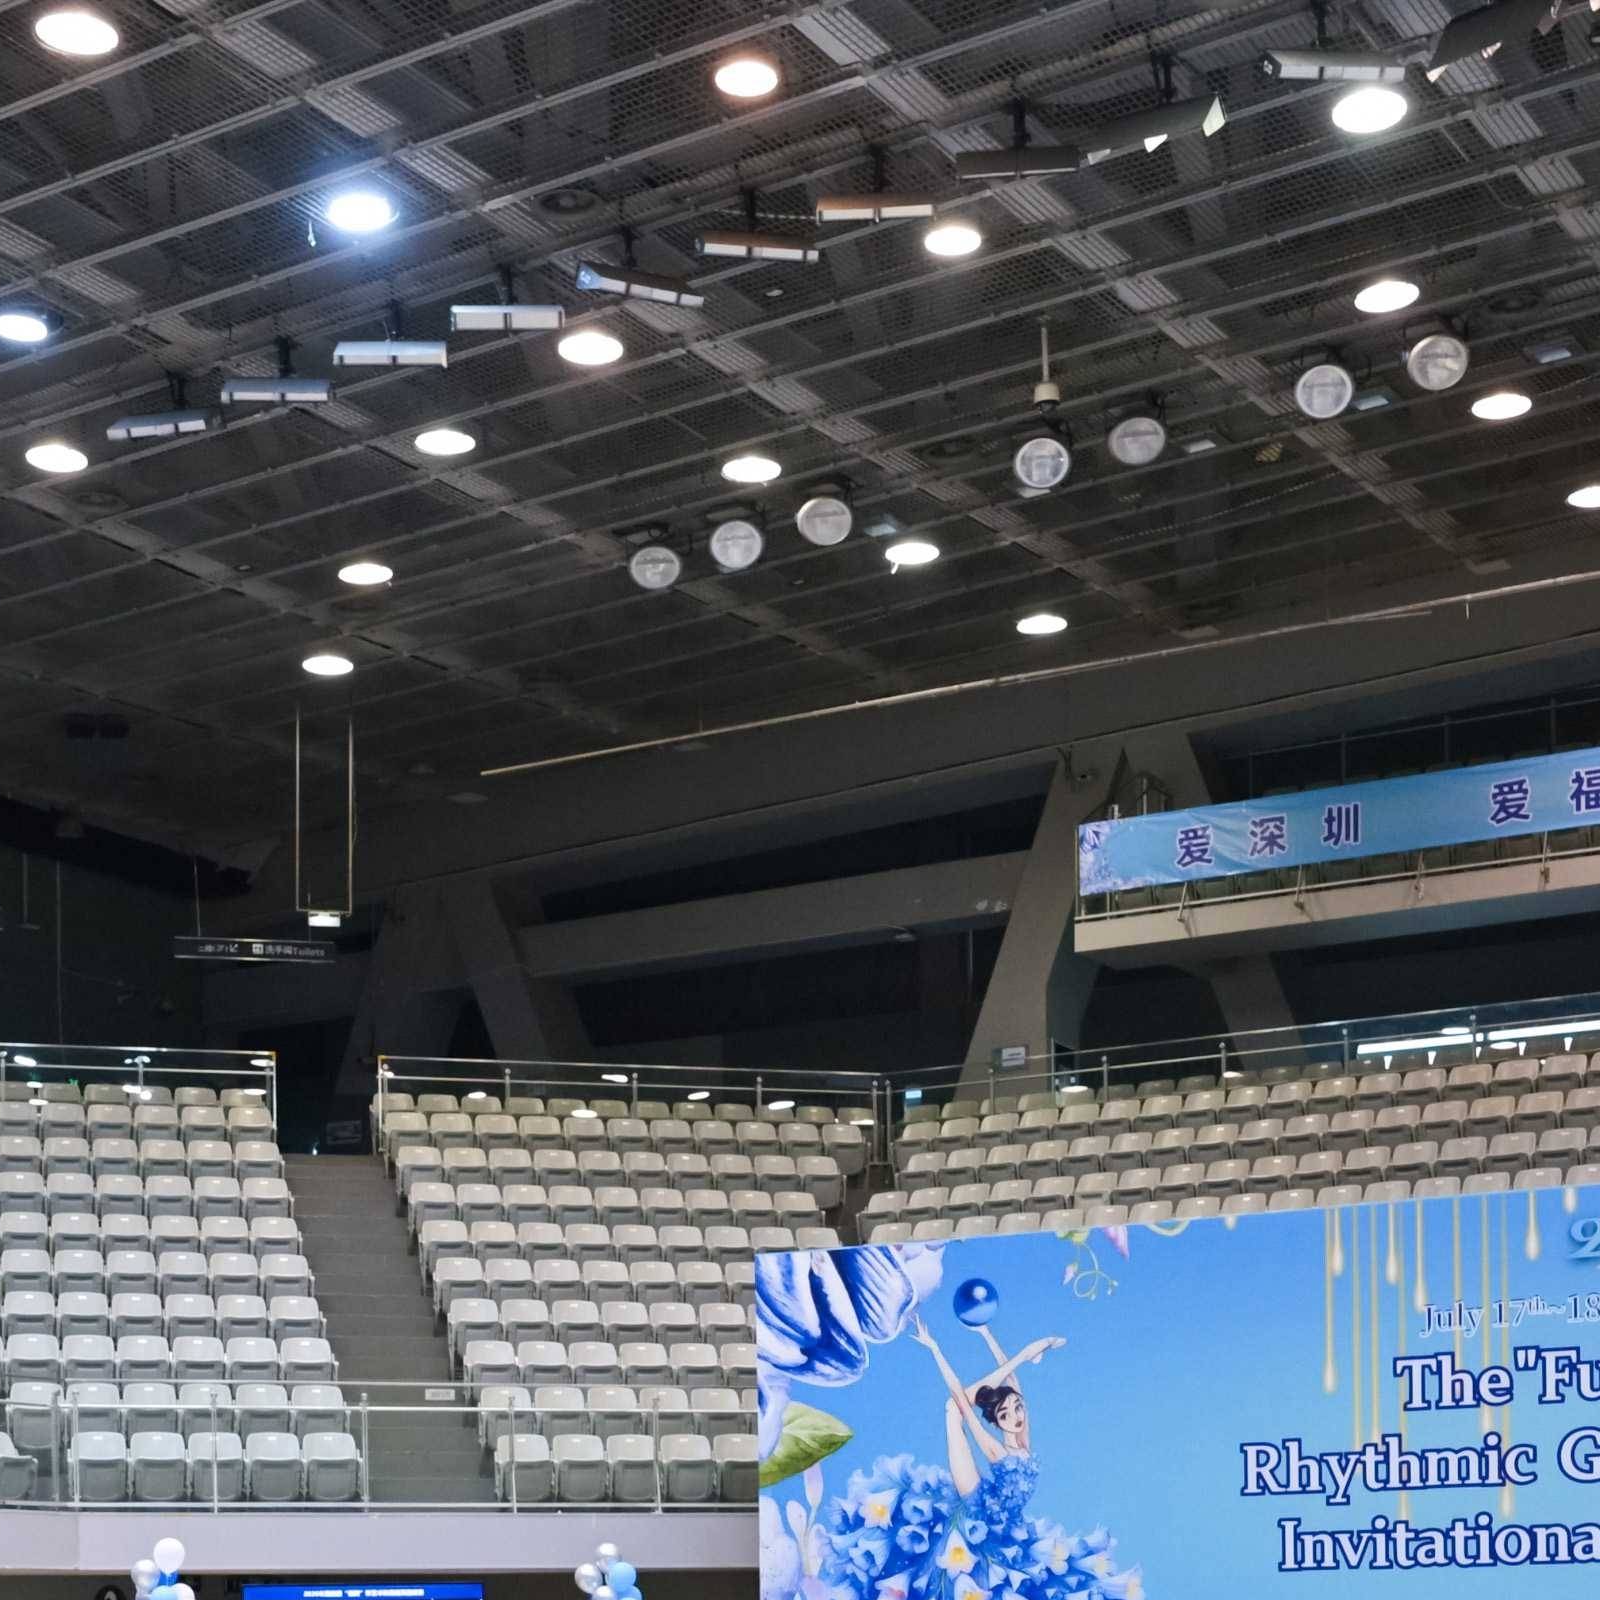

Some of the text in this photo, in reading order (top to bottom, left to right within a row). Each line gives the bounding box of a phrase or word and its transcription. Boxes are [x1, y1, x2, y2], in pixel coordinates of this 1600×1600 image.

[1176, 802, 1361, 869] 爱深圳
[1420, 1302, 1482, 1338] July
[1241, 1430, 1537, 1504] Rhythmic
